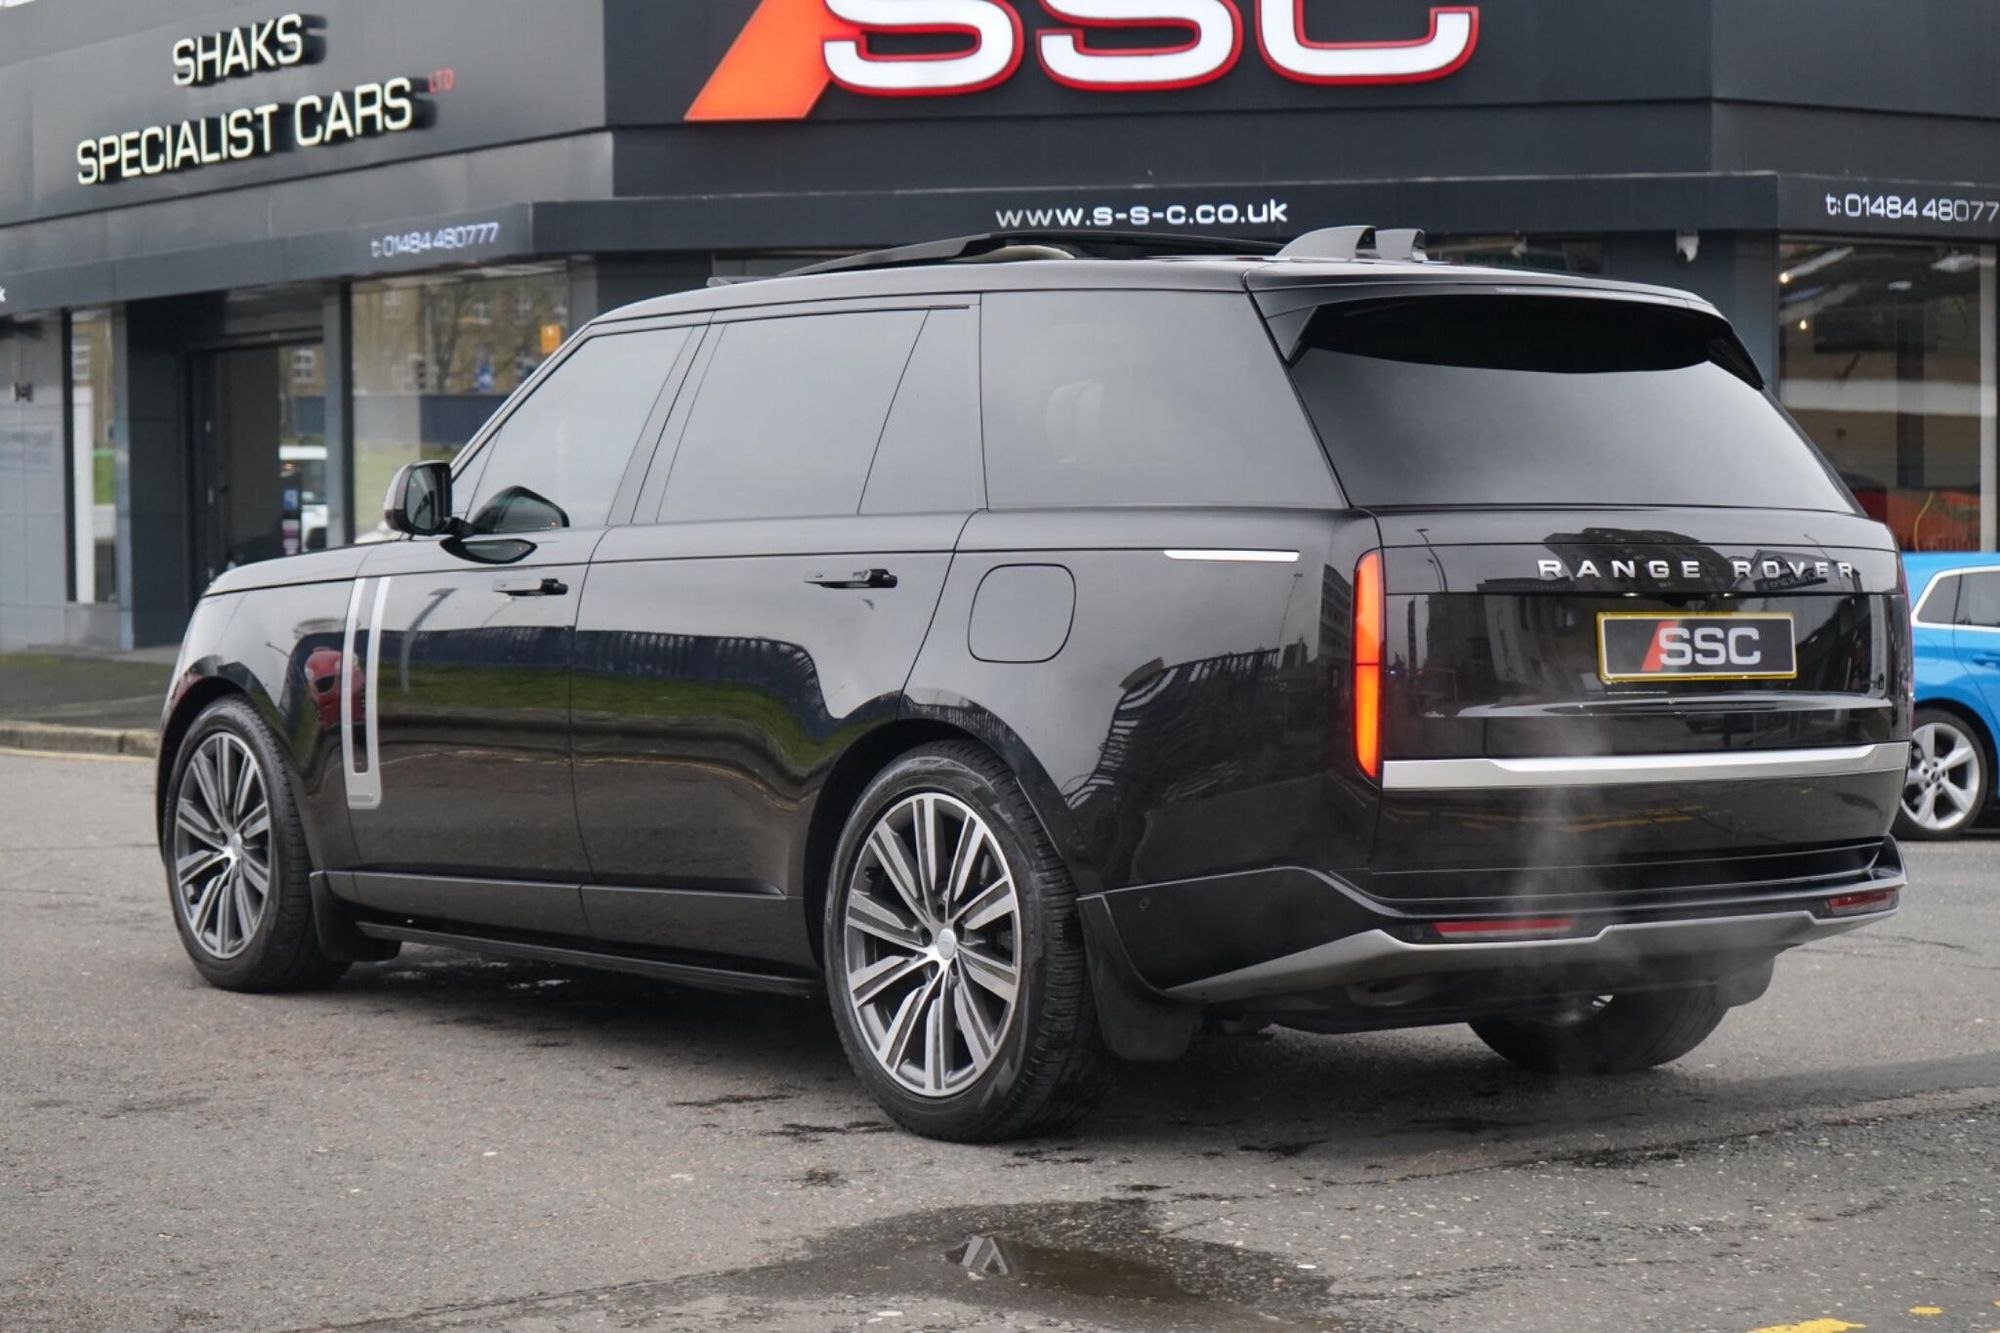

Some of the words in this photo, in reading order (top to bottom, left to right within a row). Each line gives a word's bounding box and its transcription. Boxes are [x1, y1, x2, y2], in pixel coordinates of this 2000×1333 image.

[172, 13, 303, 86] SHAKS
[76, 103, 279, 185] SPECIALIST
[294, 77, 412, 147] CARS
[428, 69, 455, 94] LTD
[995, 199, 1288, 228] www.s-s-c.co.uk
[1537, 560, 1700, 578] RANGE
[1732, 560, 1853, 578] ROVER
[1659, 627, 1761, 666] SSC
